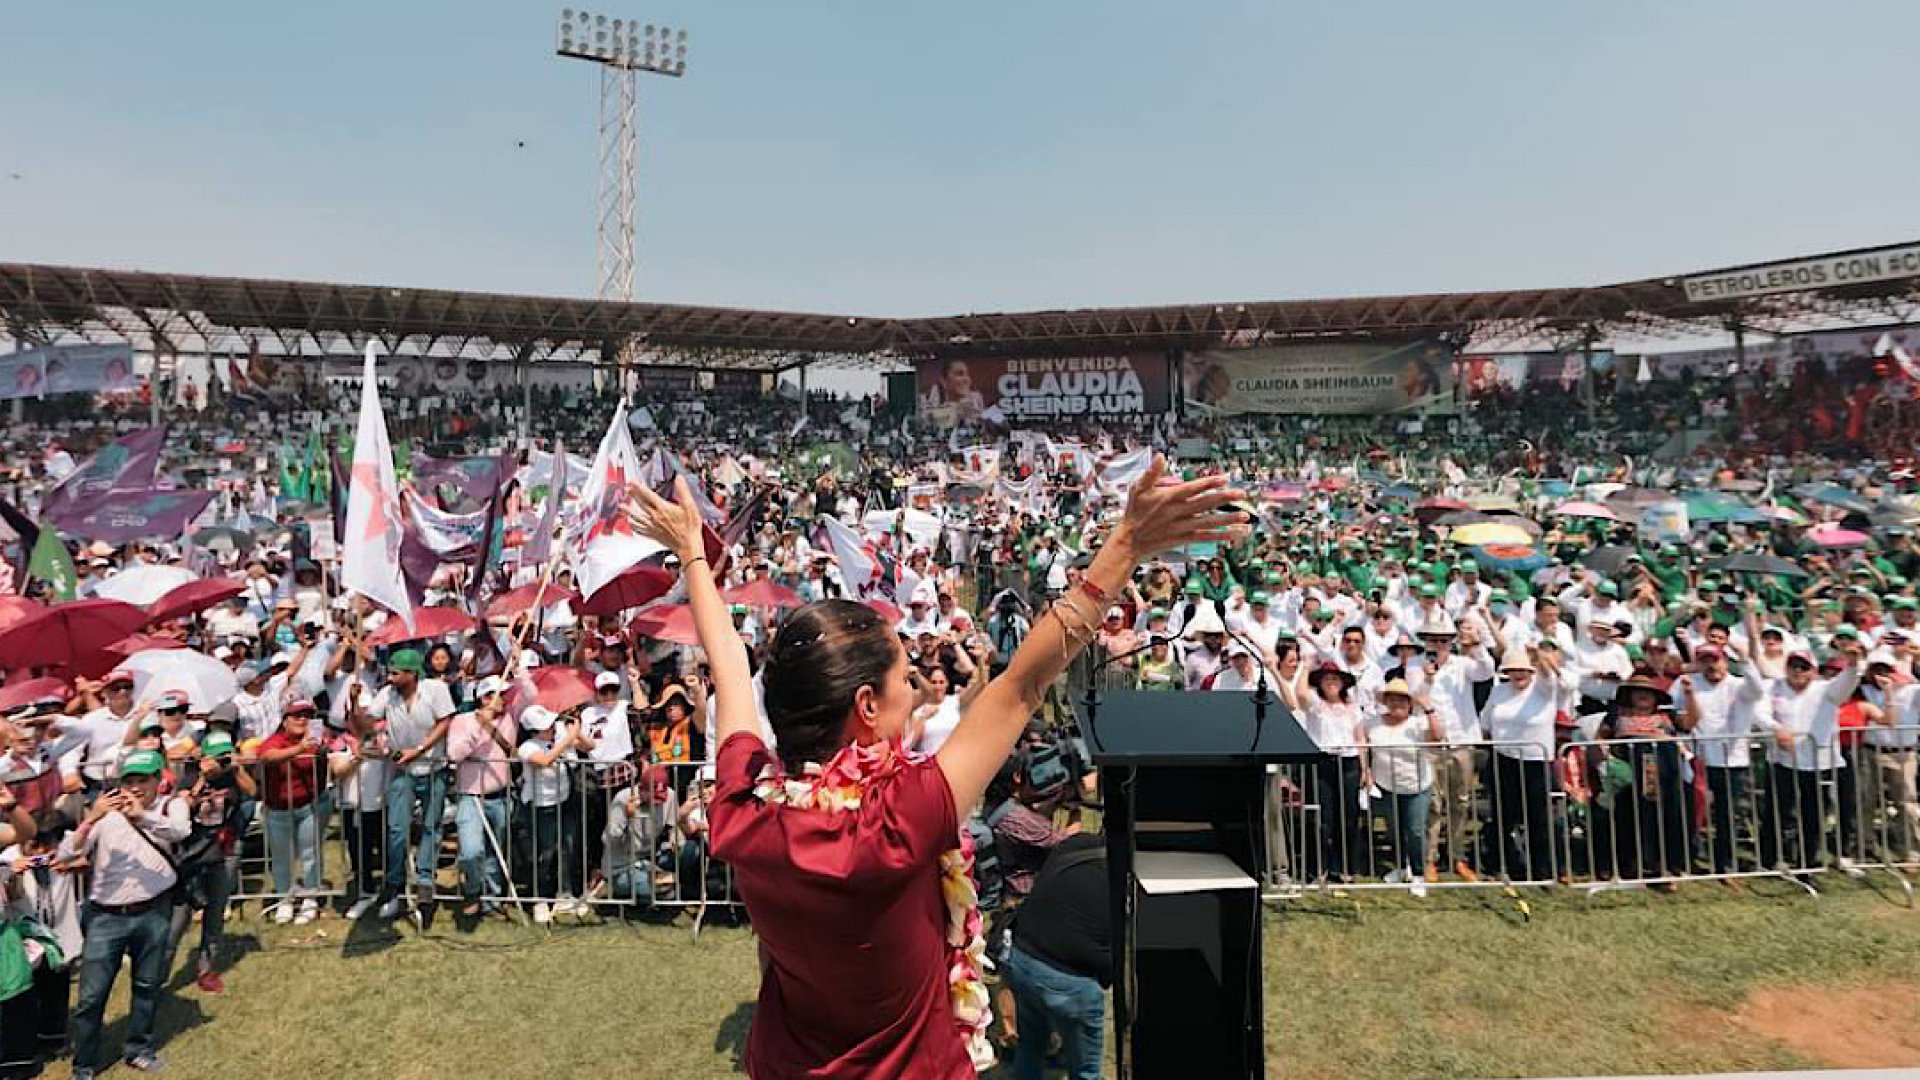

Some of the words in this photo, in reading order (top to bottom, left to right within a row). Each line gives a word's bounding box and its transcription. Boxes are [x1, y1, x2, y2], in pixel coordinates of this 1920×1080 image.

[1688, 264, 1827, 297] PETROLEROS
[1834, 257, 1882, 280] CON
[1007, 356, 1131, 372] BIENVENIDA
[998, 371, 1143, 396] CLAUDIA
[1235, 376, 1299, 392] CLAUDIA
[1303, 375, 1394, 390] SHEINBAUM
[998, 395, 1144, 414] SHEINBAUM
